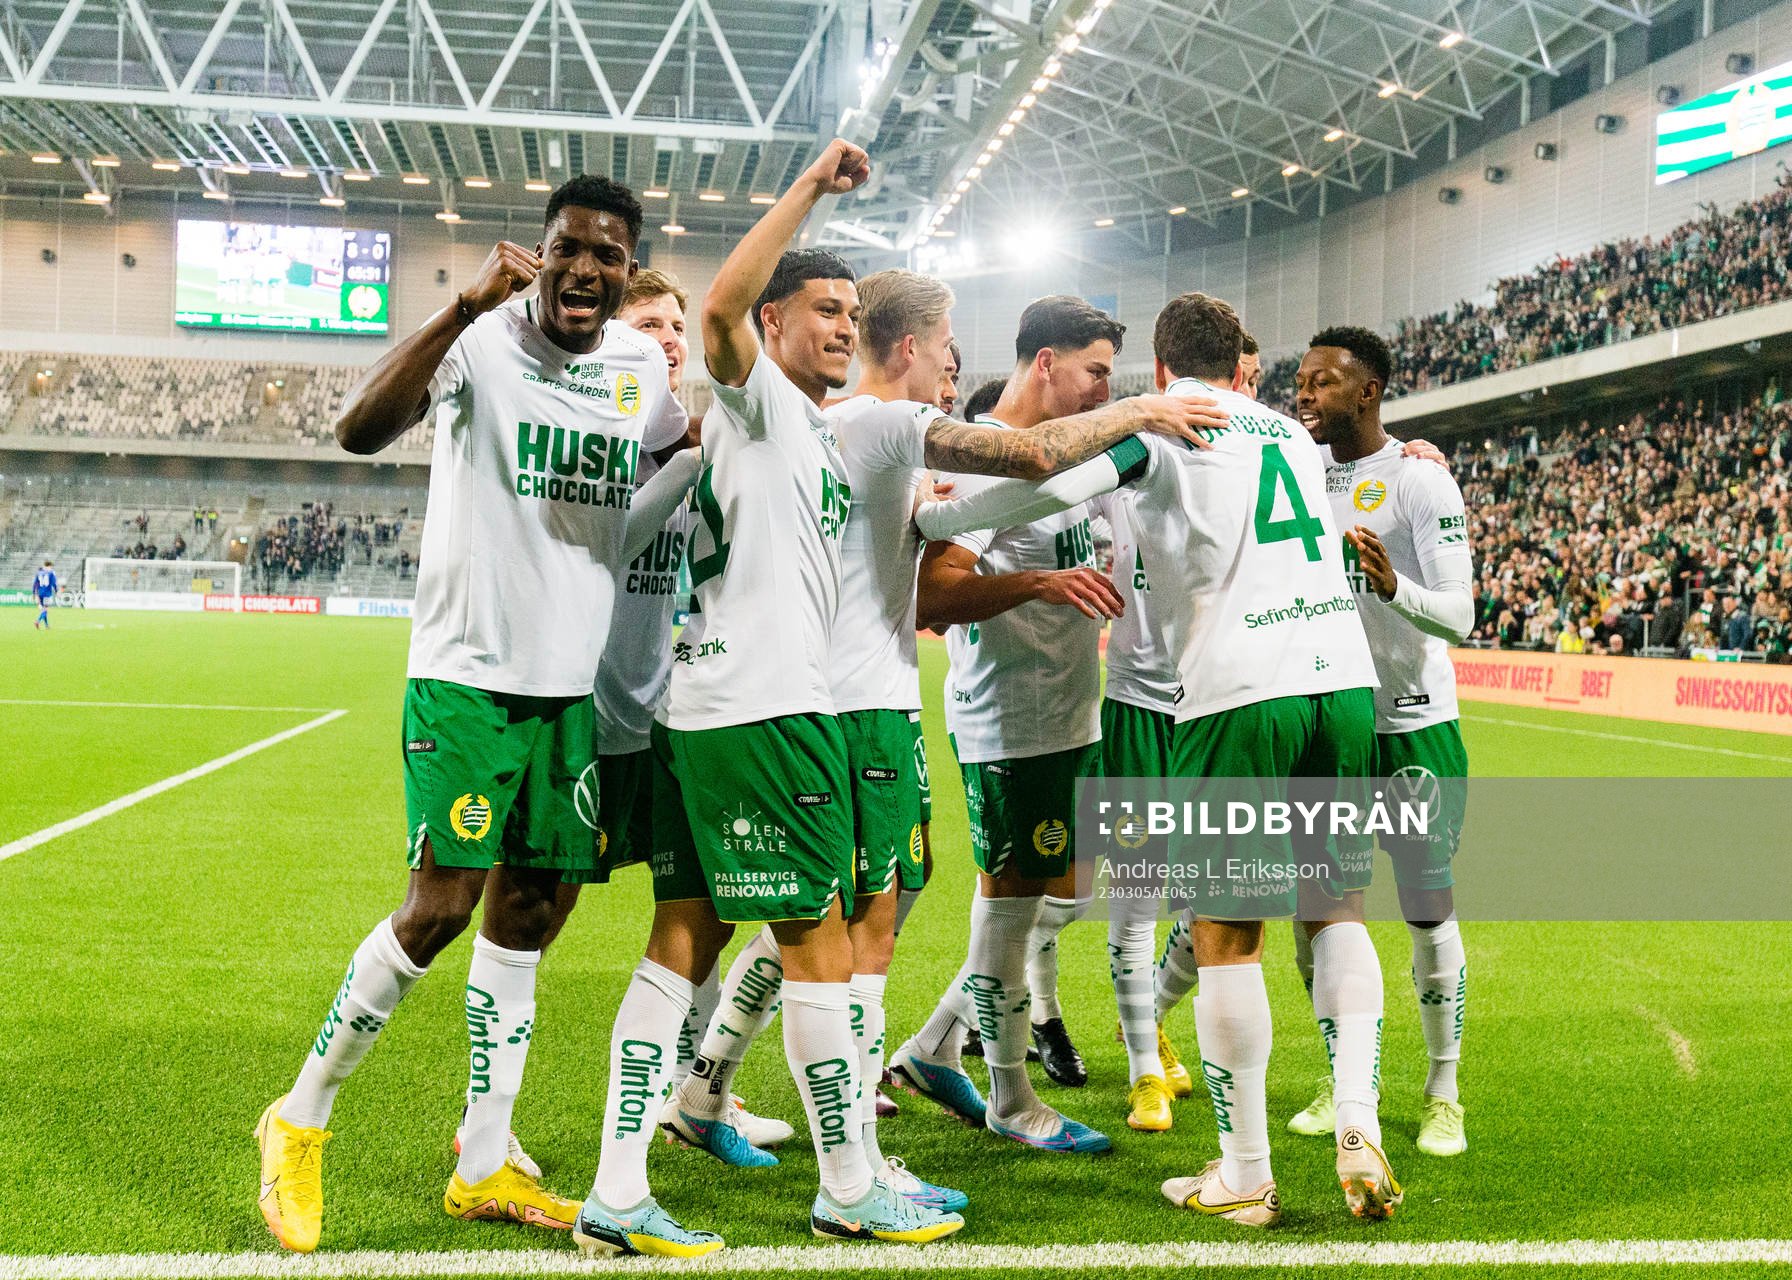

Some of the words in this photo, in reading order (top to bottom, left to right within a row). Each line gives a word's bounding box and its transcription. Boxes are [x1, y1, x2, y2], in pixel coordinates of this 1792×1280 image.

[580, 371, 603, 380] SPORT
[581, 362, 604, 371] INTER
[517, 421, 639, 485] HUSKI
[516, 473, 632, 510] CHOCOLATE
[1253, 443, 1326, 562] 4
[244, 597, 318, 613] CHOCOLATE
[358, 601, 410, 616] Flinks
[1510, 664, 1544, 692] KAFFE
[1675, 676, 1792, 717] SINNESSCHYS
[723, 837, 786, 853] STRÅLE
[714, 871, 798, 883] PALLSERVICE
[716, 883, 776, 897] RENOVA
[778, 882, 800, 896] AB
[466, 984, 500, 1095] Clinton
[618, 1039, 662, 1134] Clinton
[805, 1057, 852, 1148] Clinton
